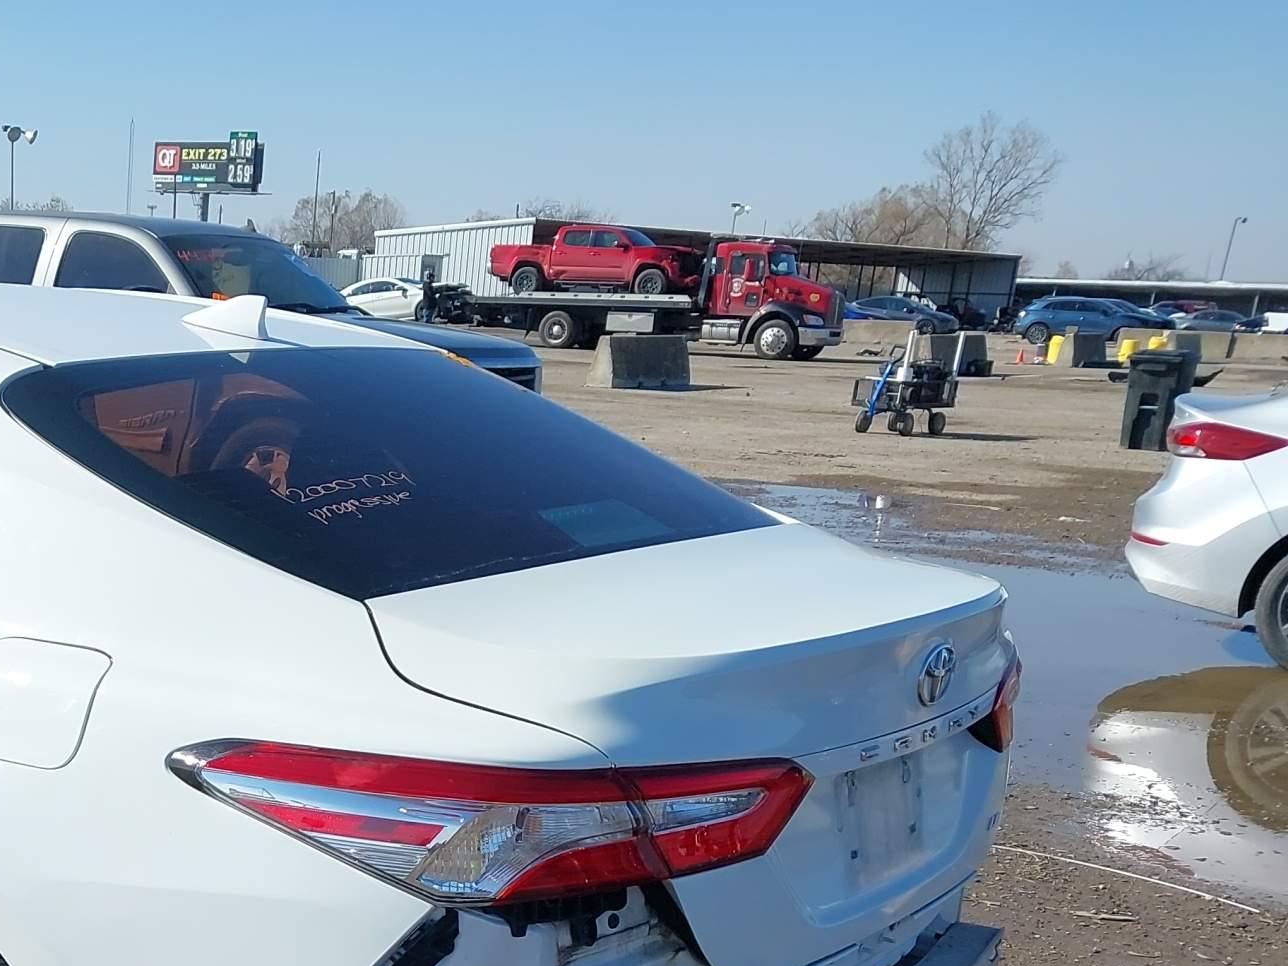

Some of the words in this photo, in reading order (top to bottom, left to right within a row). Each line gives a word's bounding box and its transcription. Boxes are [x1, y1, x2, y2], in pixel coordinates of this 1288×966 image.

[158, 149, 177, 169] QT
[181, 149, 206, 160] EXIT
[207, 149, 228, 160] 273
